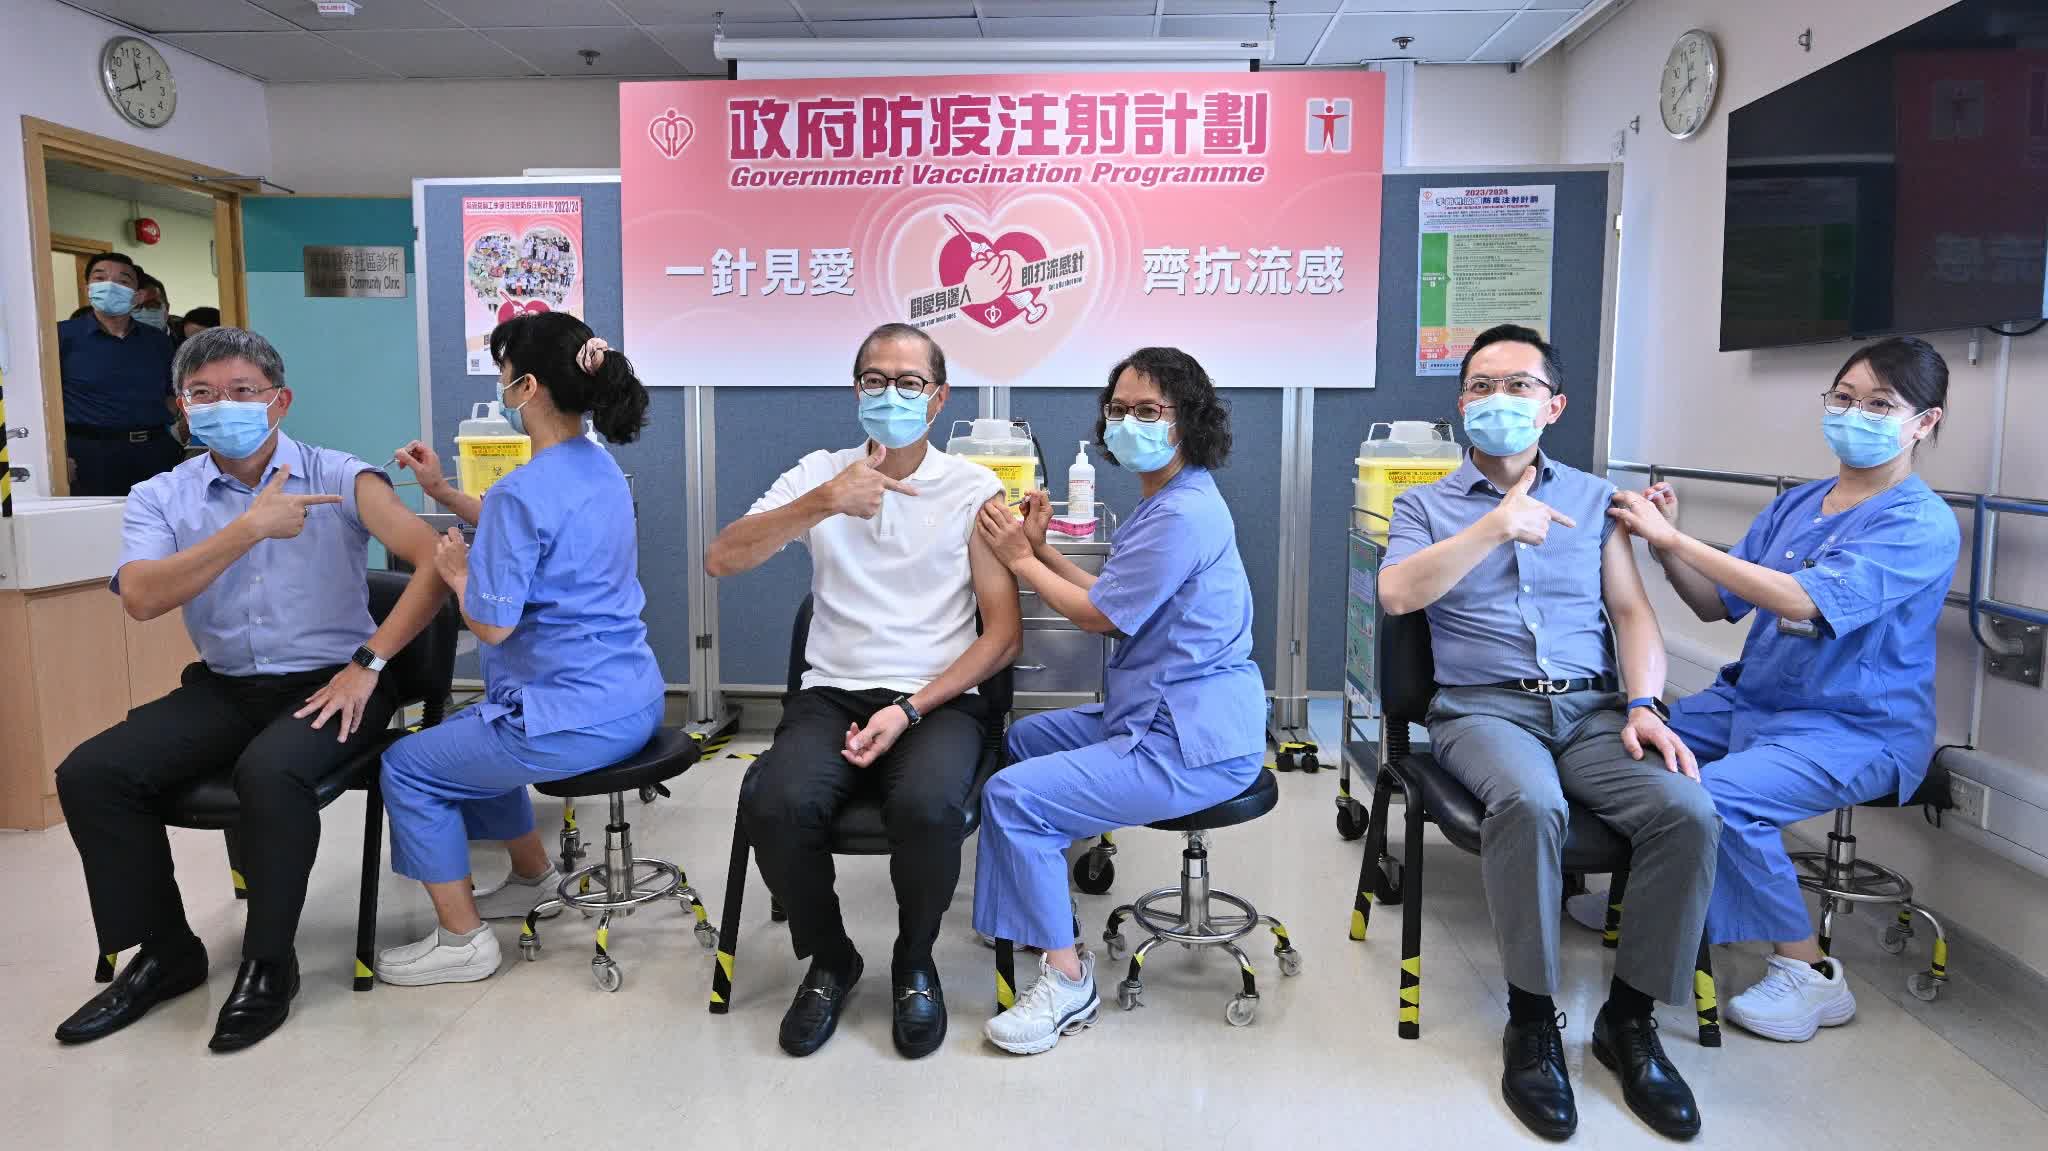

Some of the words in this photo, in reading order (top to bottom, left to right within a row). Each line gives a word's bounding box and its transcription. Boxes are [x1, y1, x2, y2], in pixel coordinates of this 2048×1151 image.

[729, 92, 1267, 160] 政府防疫注射計劃
[730, 164, 905, 187] Government
[912, 163, 1082, 186] Vaccination
[1090, 162, 1265, 187] Programme
[1465, 188, 1508, 197] 2023/2024
[349, 275, 381, 293] Community
[665, 247, 857, 297] 一針見愛
[1021, 250, 1085, 287] 即打流感針
[1142, 246, 1345, 295] 齊抗流感
[910, 284, 972, 319] 關愛身邊人
